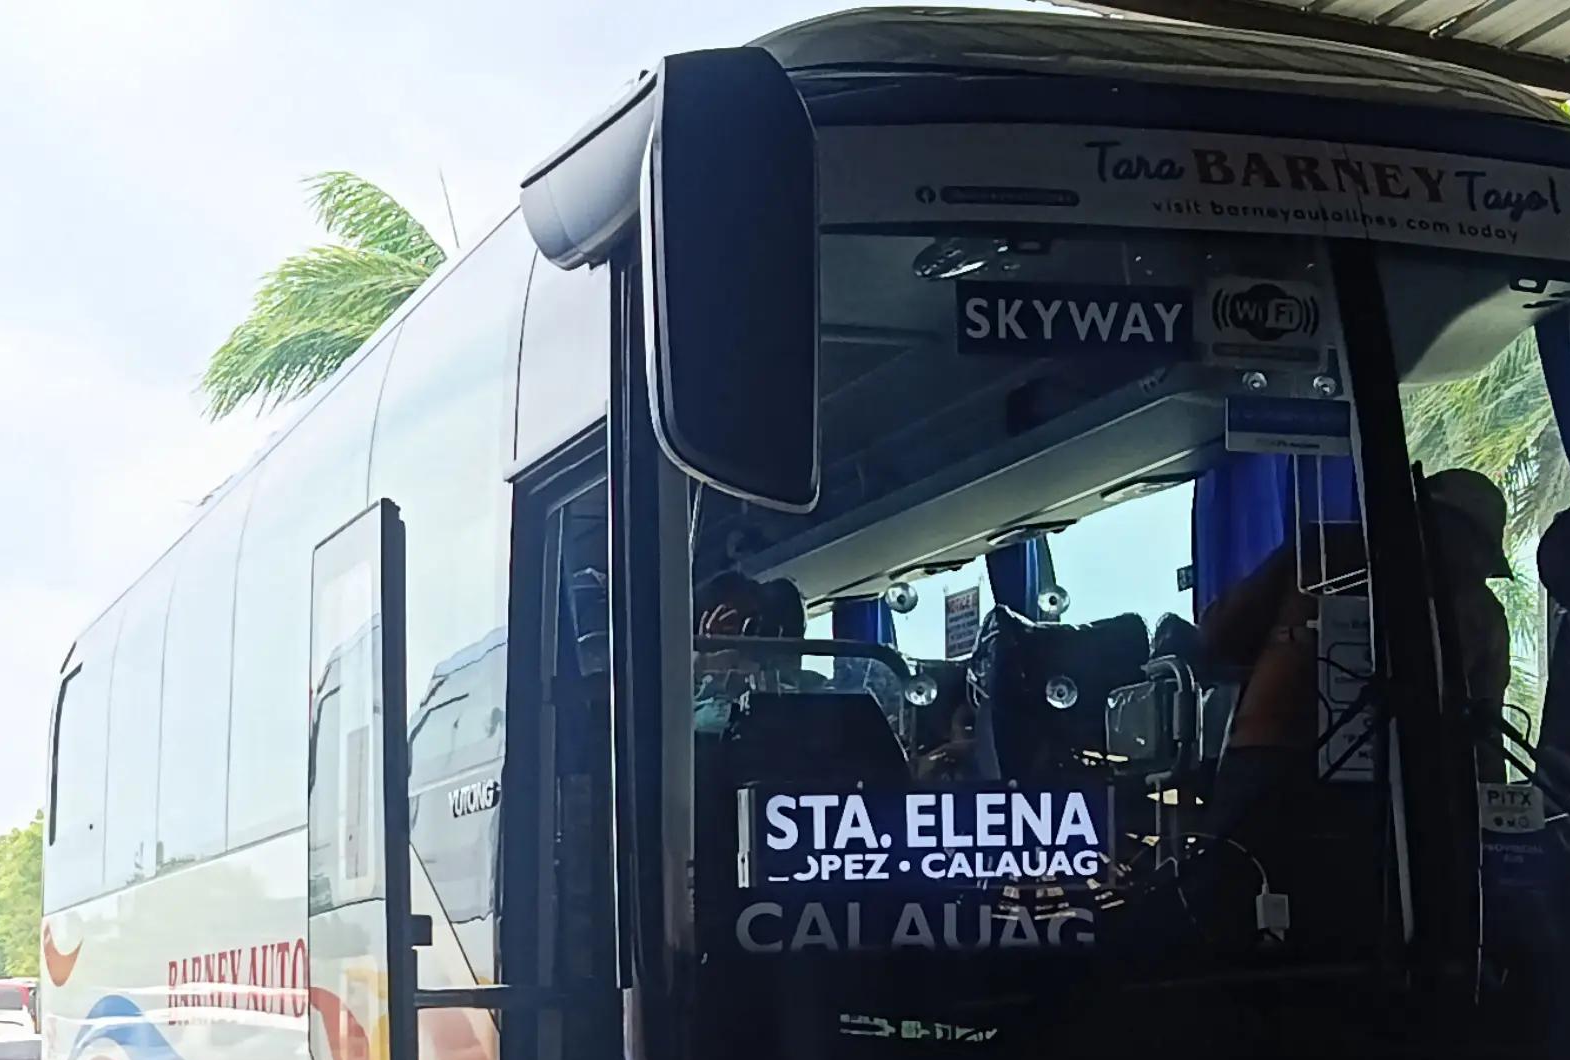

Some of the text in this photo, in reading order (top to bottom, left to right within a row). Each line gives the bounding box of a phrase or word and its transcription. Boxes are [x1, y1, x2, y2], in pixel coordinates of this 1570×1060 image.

[1084, 140, 1185, 182] Tara
[1191, 147, 1449, 203] BARNEY
[1152, 199, 1201, 216] visit
[1458, 222, 1519, 246] today
[964, 297, 1183, 344] SKYWAY
[448, 779, 497, 817] YUTONG
[765, 791, 1100, 851] STA. ELENA
[1487, 789, 1532, 807] PITX
[767, 849, 1099, 882] OPEZ CALAUAG
[247, 938, 308, 1019] AUTO
